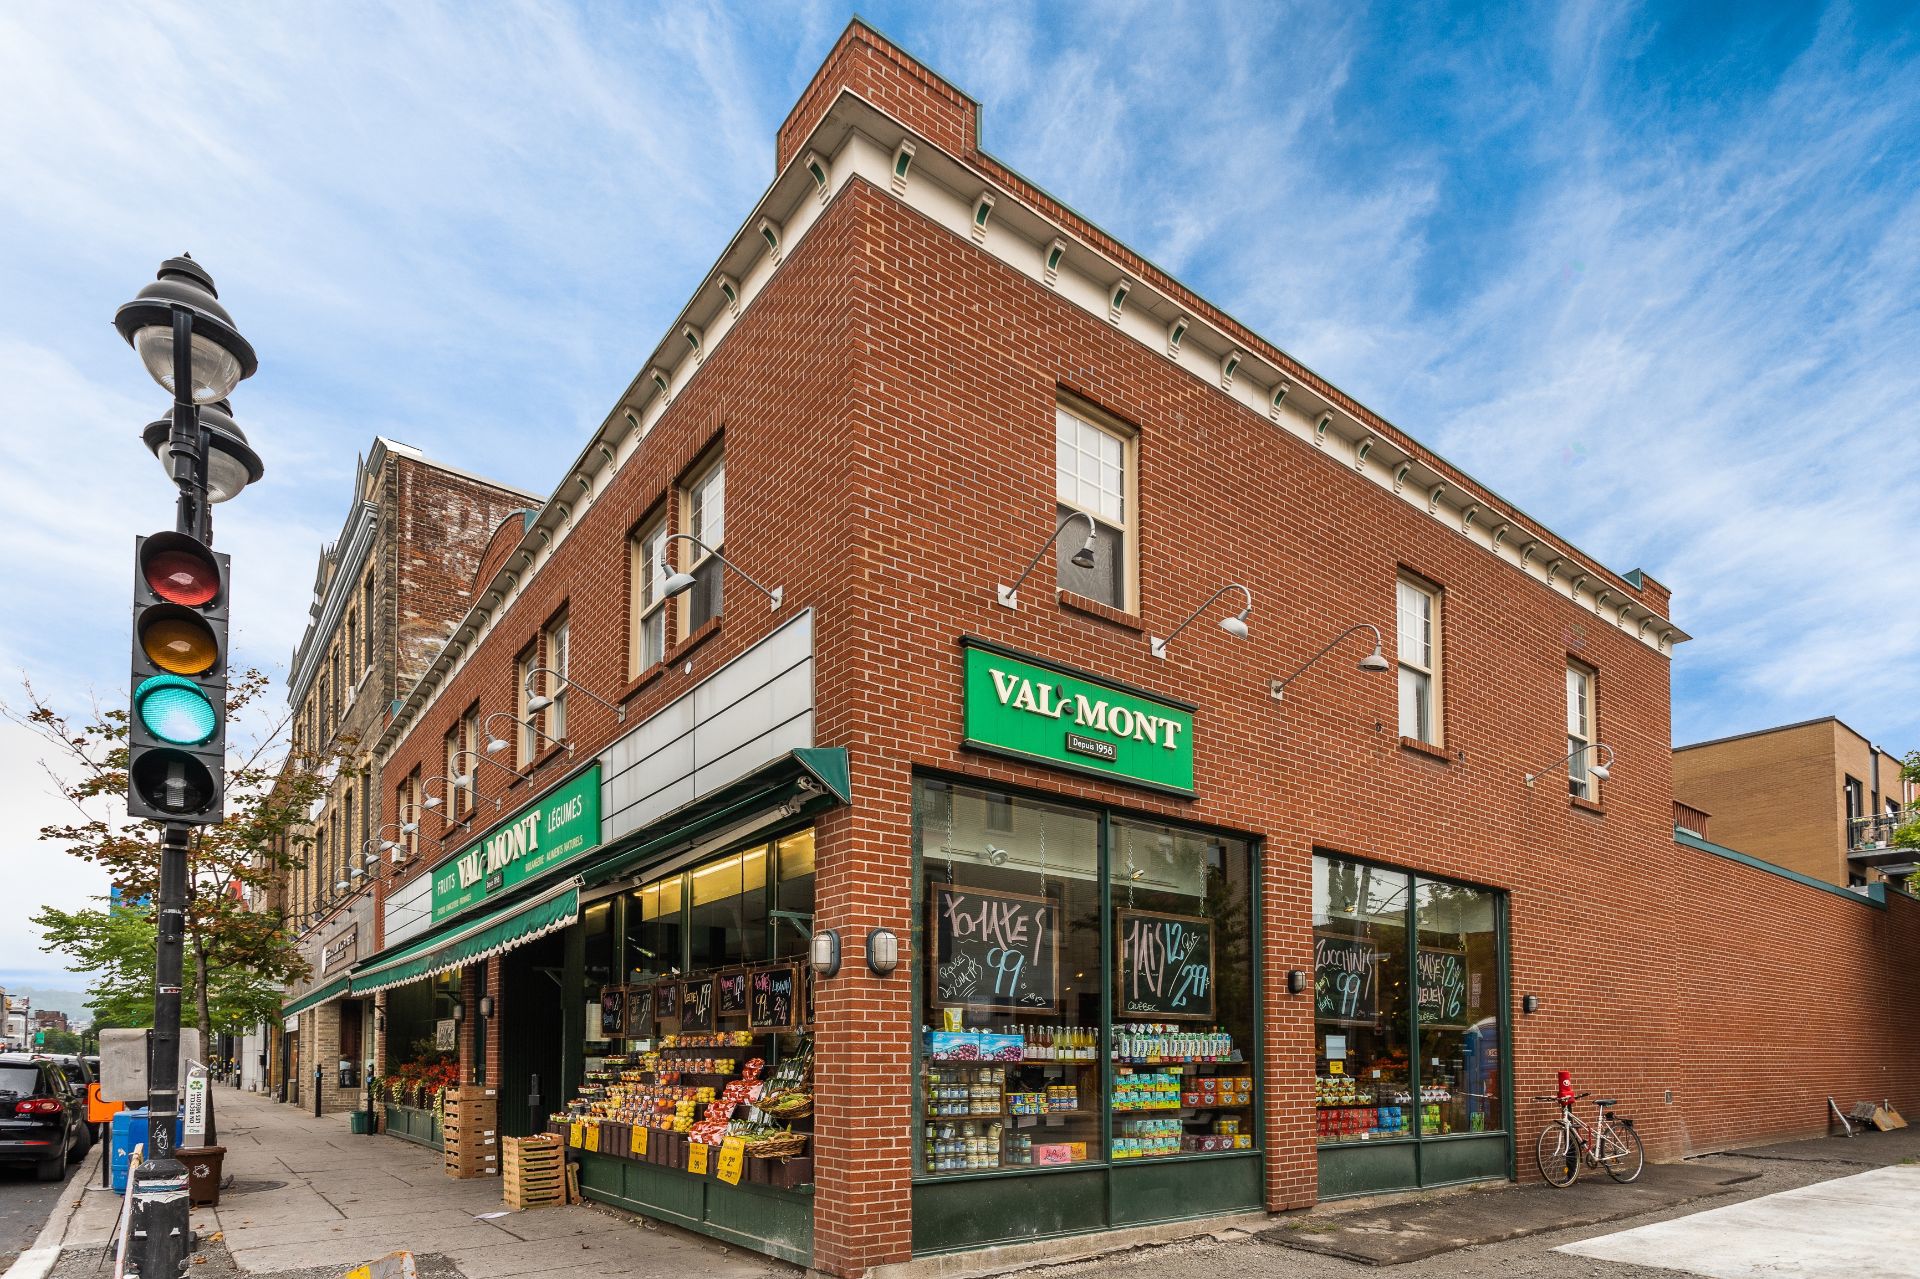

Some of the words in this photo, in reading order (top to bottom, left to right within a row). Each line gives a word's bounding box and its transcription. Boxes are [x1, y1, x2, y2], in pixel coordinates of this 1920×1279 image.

[1073, 738, 1094, 750] Depuis
[1096, 743, 1112, 755] 1958
[548, 794, 582, 832] LÉGUMES
[438, 873, 455, 896] FRUITS
